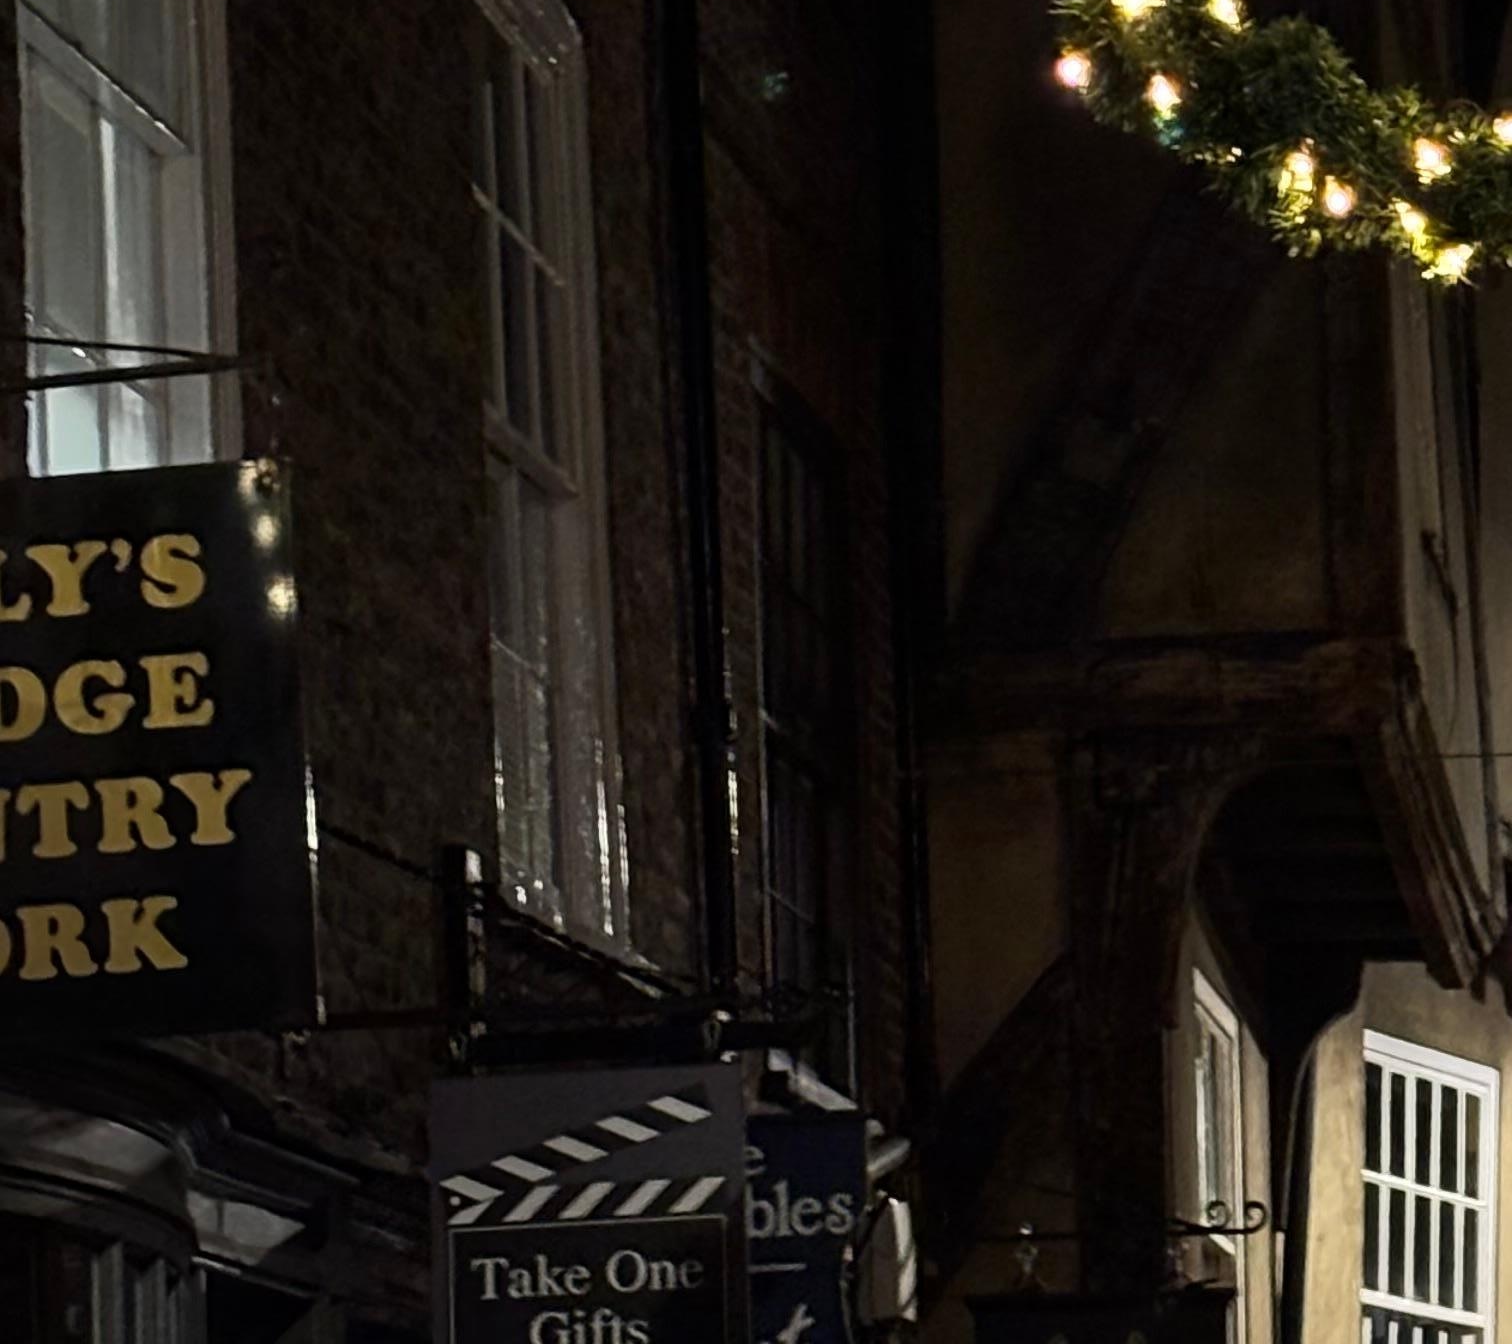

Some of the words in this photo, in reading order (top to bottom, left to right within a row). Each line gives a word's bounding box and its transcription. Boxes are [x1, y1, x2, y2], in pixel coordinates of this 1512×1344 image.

[0, 768, 252, 864] TRY
[0, 894, 189, 980] RK
[470, 1256, 591, 1301] Take
[605, 1249, 704, 1293] One
